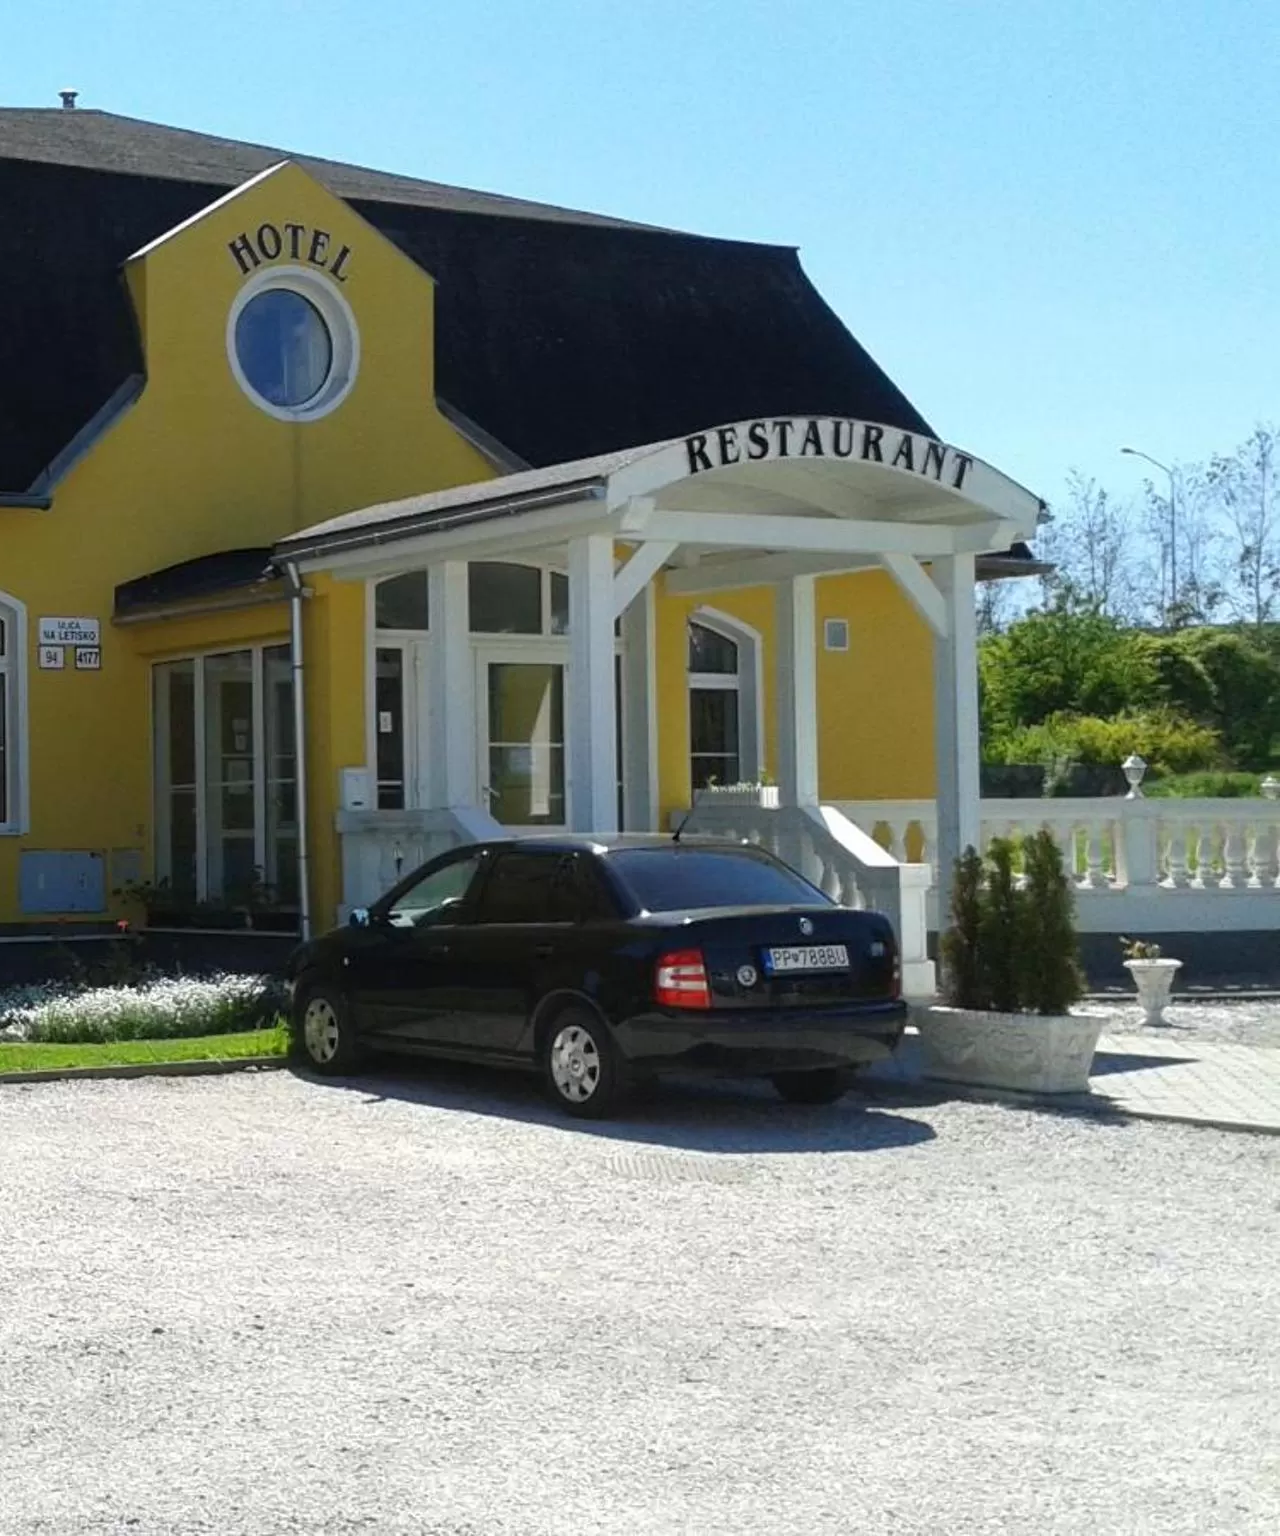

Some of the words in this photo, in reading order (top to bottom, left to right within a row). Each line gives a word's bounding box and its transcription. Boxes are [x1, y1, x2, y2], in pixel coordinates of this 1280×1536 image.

[228, 223, 351, 282] HOTEL
[684, 419, 974, 490] RESTAURANT
[45, 650, 58, 664] 94
[78, 651, 99, 664] 4177
